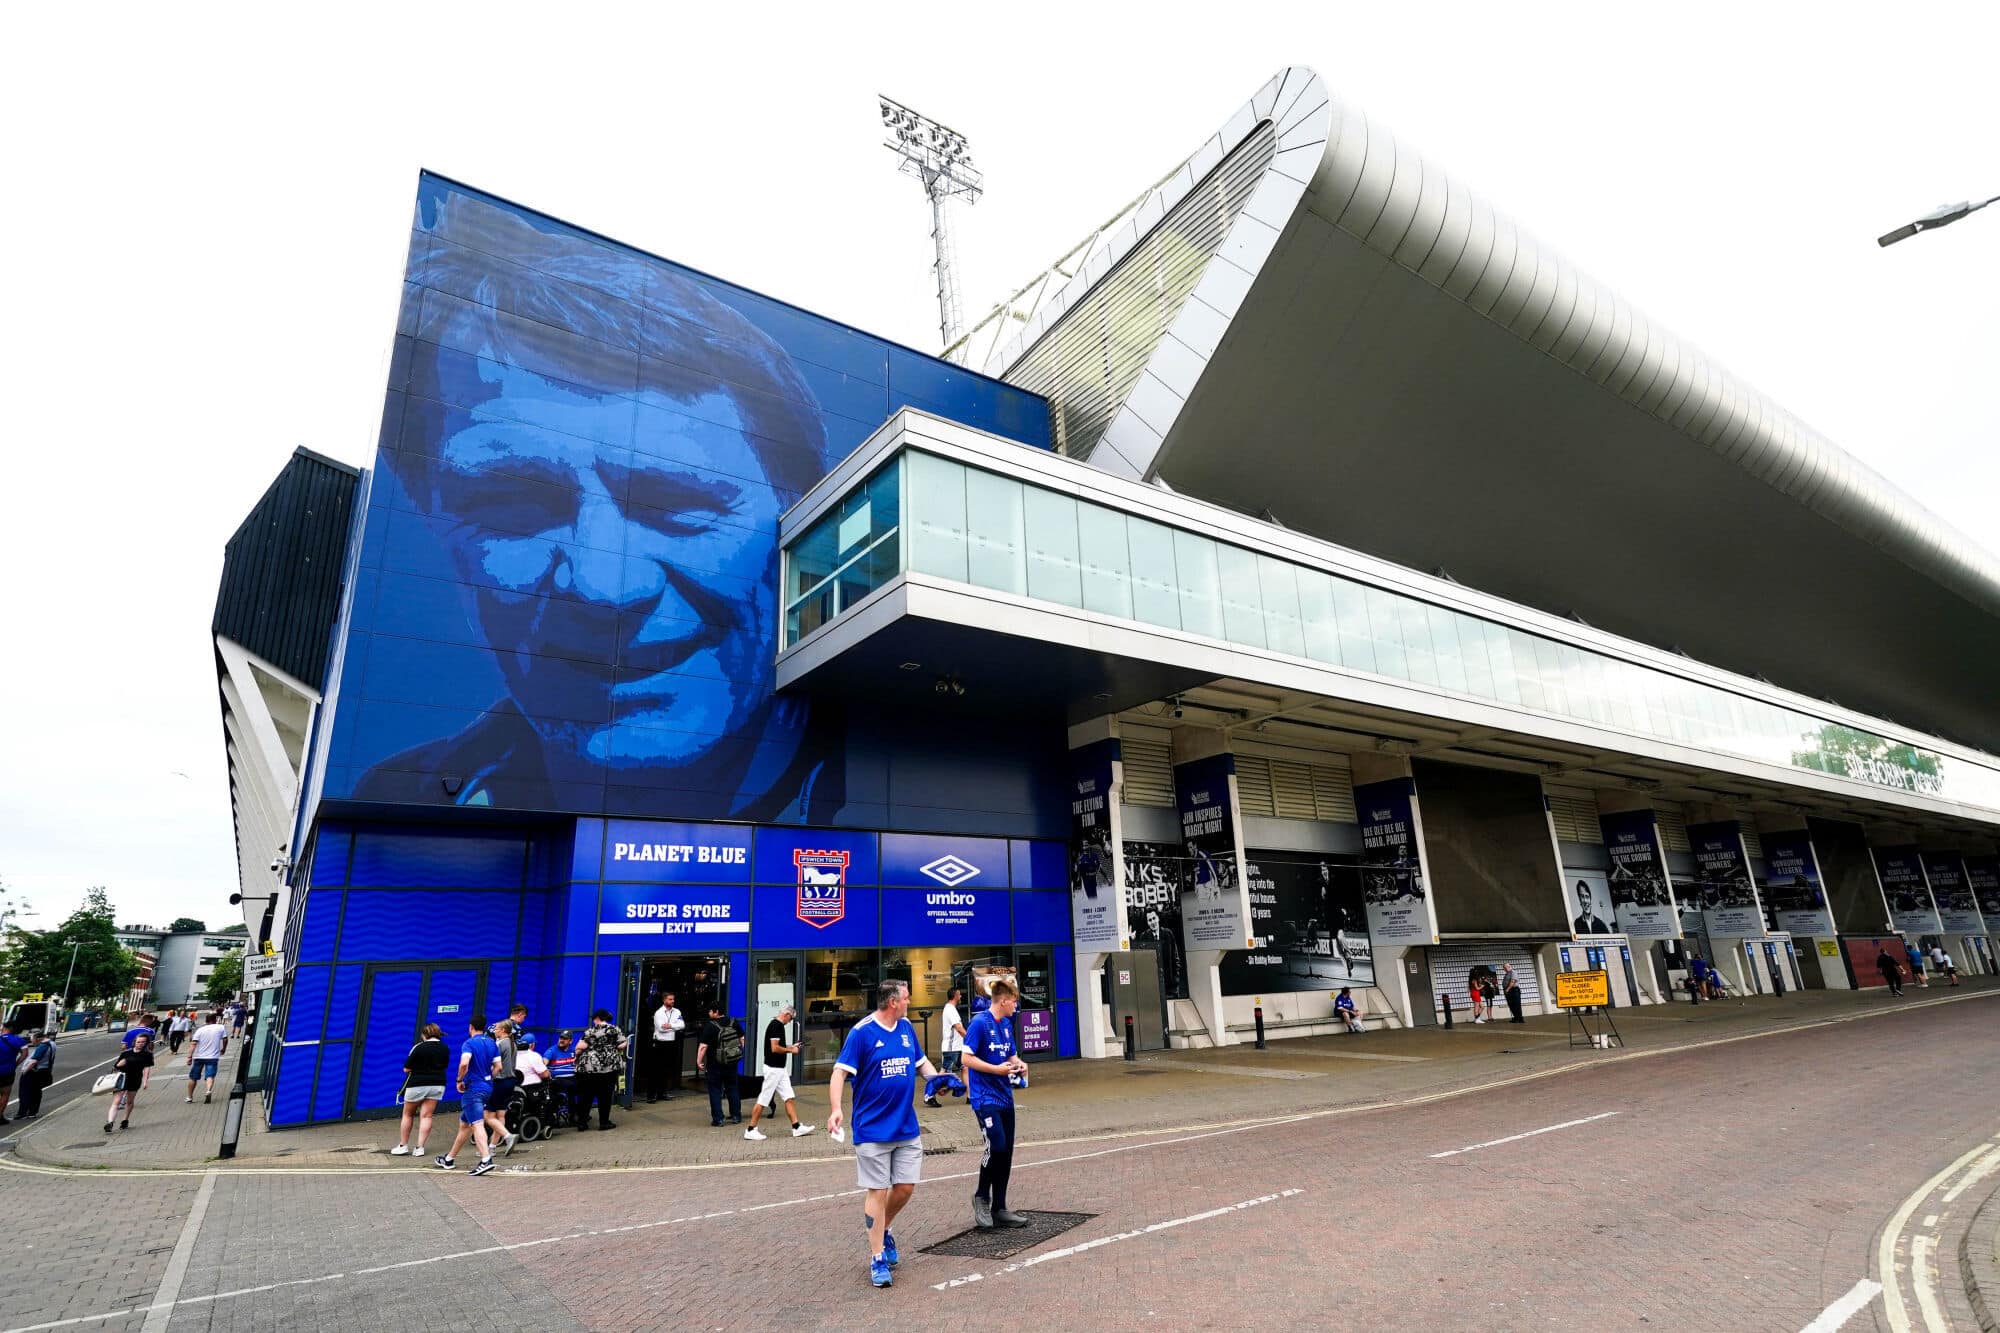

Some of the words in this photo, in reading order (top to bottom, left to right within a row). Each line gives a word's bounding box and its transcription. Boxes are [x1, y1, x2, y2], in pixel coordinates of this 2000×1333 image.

[1195, 805, 1223, 823] INSPIRES
[1185, 822, 1204, 838] MAGIC
[1204, 819, 1223, 834] NIGHT
[614, 842, 694, 862] PLANET
[697, 846, 746, 864] BLUE
[1630, 852, 1652, 863] CROWD
[926, 890, 976, 905] umbro
[1124, 882, 1178, 907] BOBBY
[626, 904, 677, 918] SUPER
[682, 904, 731, 918] STORE
[666, 922, 694, 934] EXIT
[1023, 1025, 1049, 1033] Disabled
[1040, 1040, 1049, 1048] D4
[881, 1056, 911, 1068] CARERS
[881, 1066, 907, 1077] TRUST
